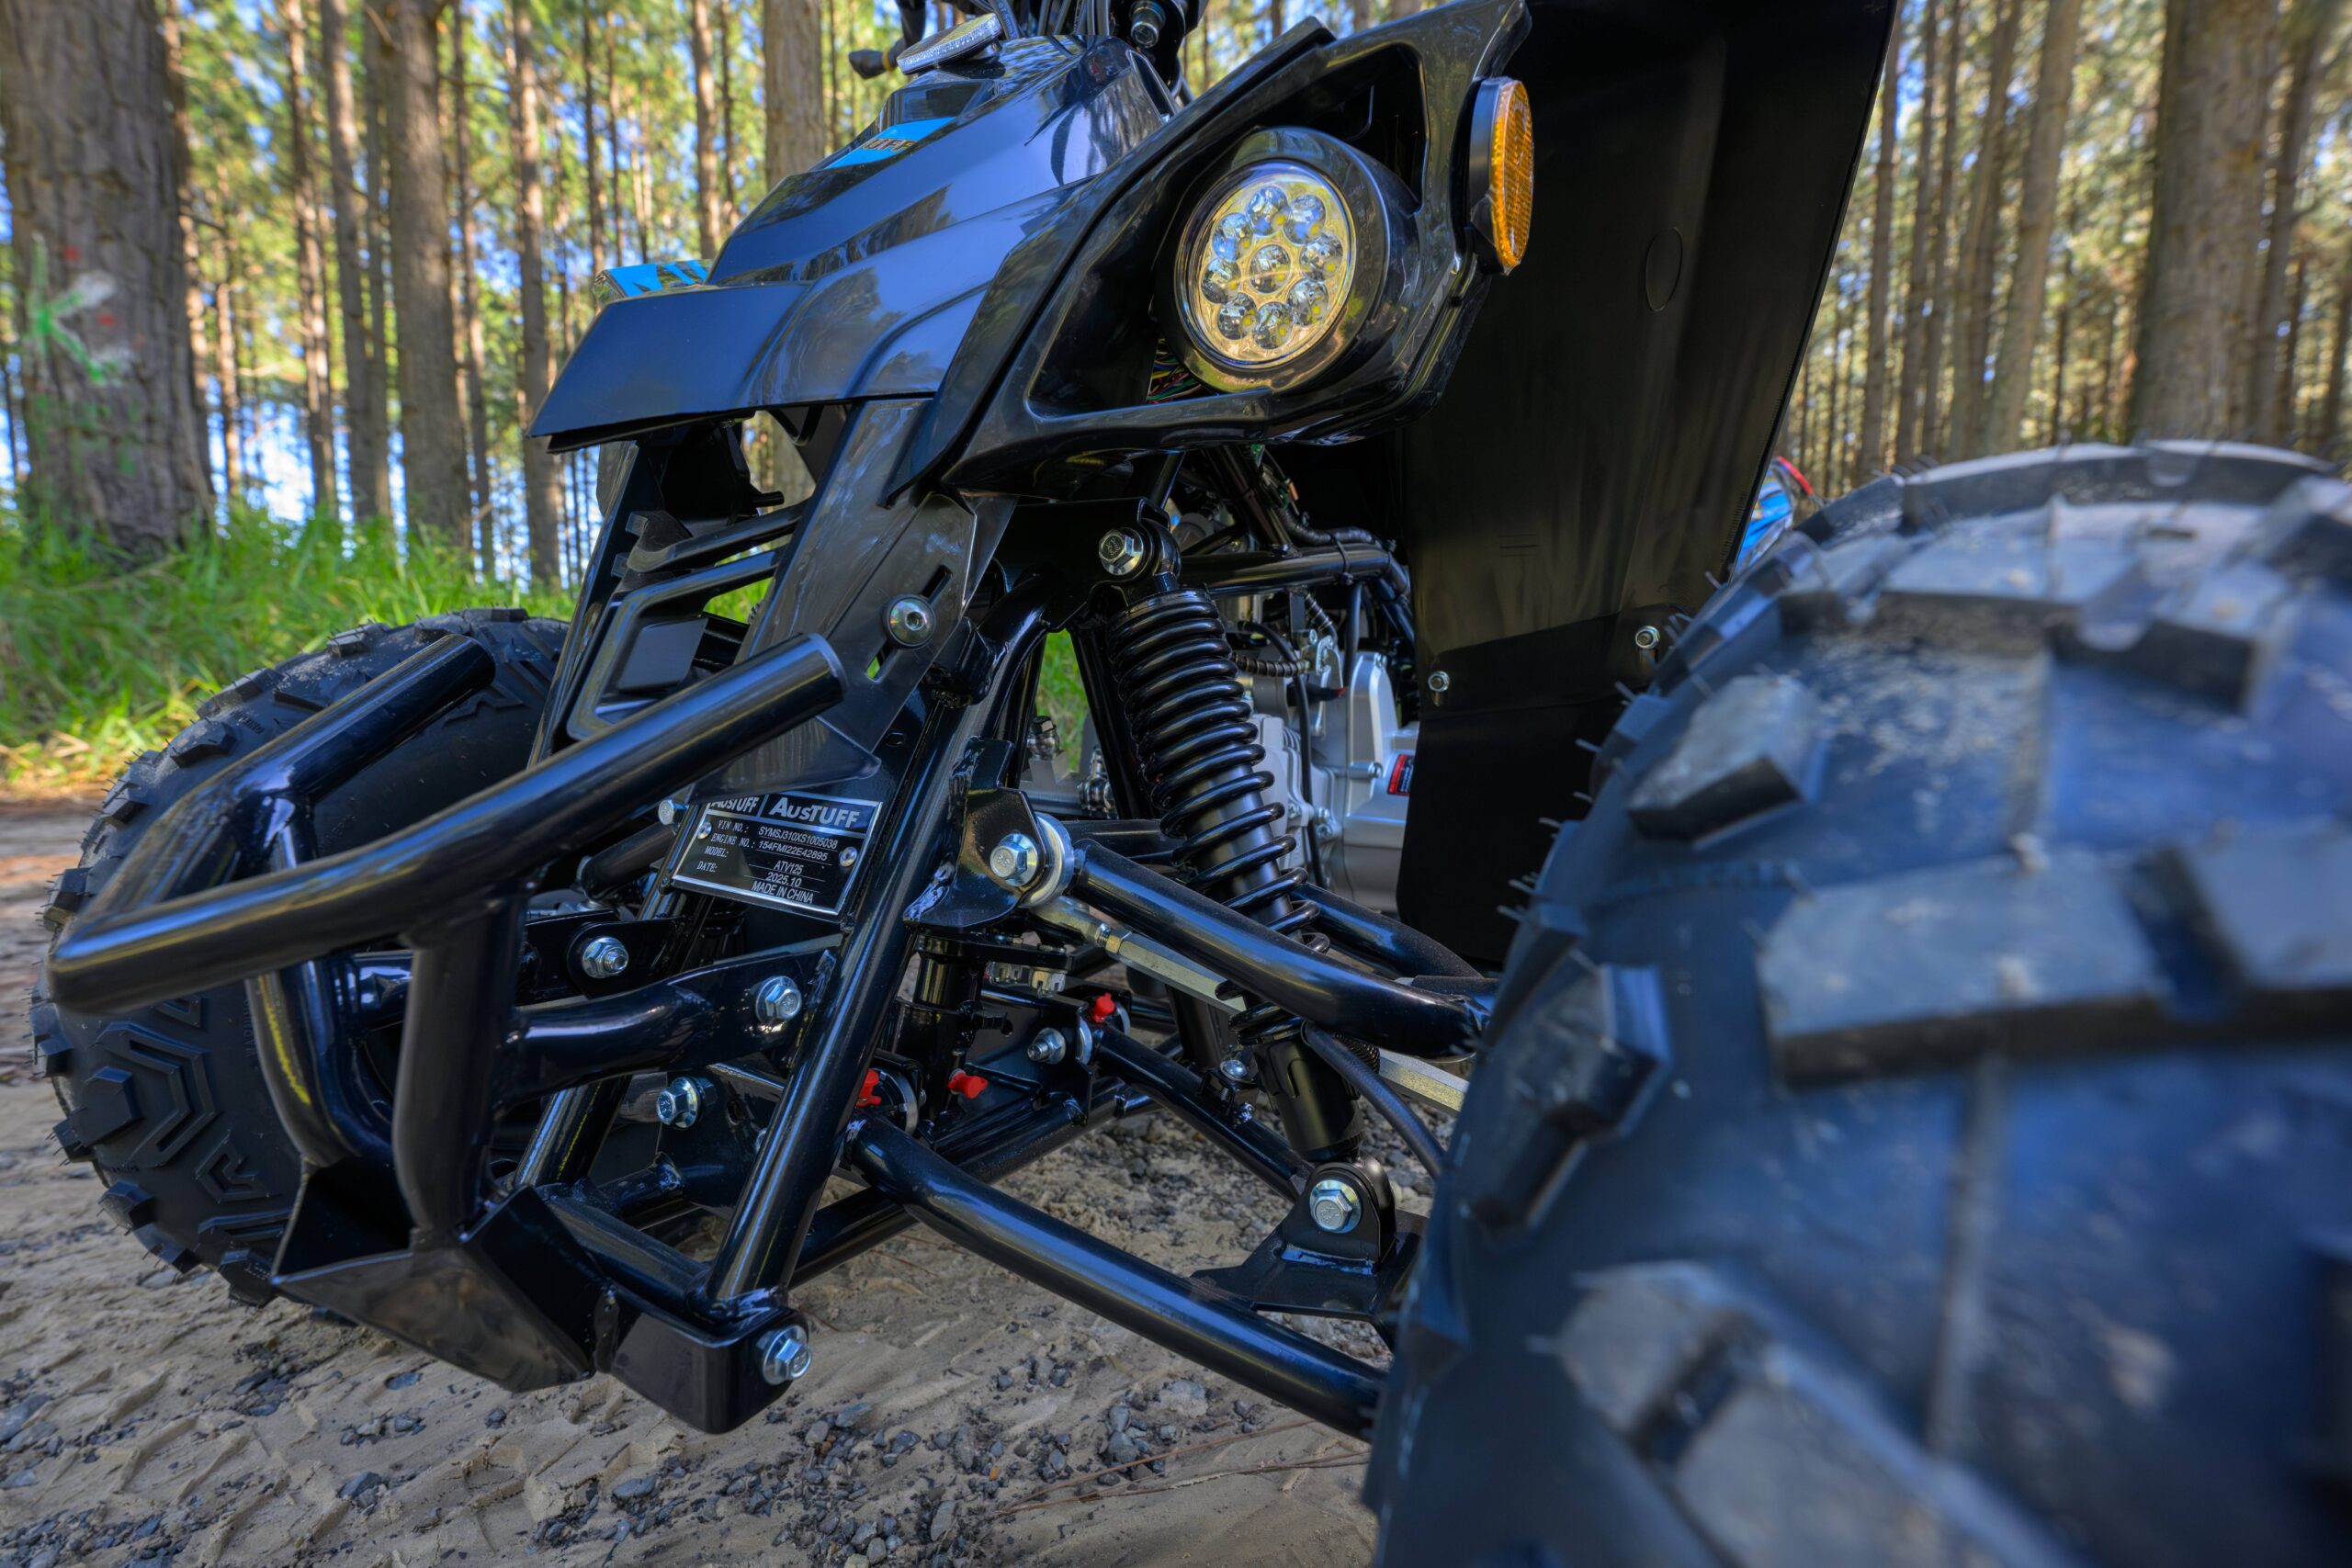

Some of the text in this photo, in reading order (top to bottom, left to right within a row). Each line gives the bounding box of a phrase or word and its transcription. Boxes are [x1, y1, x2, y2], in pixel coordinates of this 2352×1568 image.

[711, 833, 737, 845] ENGINE
[718, 819, 732, 830] VIN
[758, 826, 838, 850] SYMSJ310XS1005038
[704, 845, 804, 875] MODEL: ATV125
[696, 861, 802, 887] DATE: 2025.10
[752, 881, 814, 905] MADE IN CHINA
